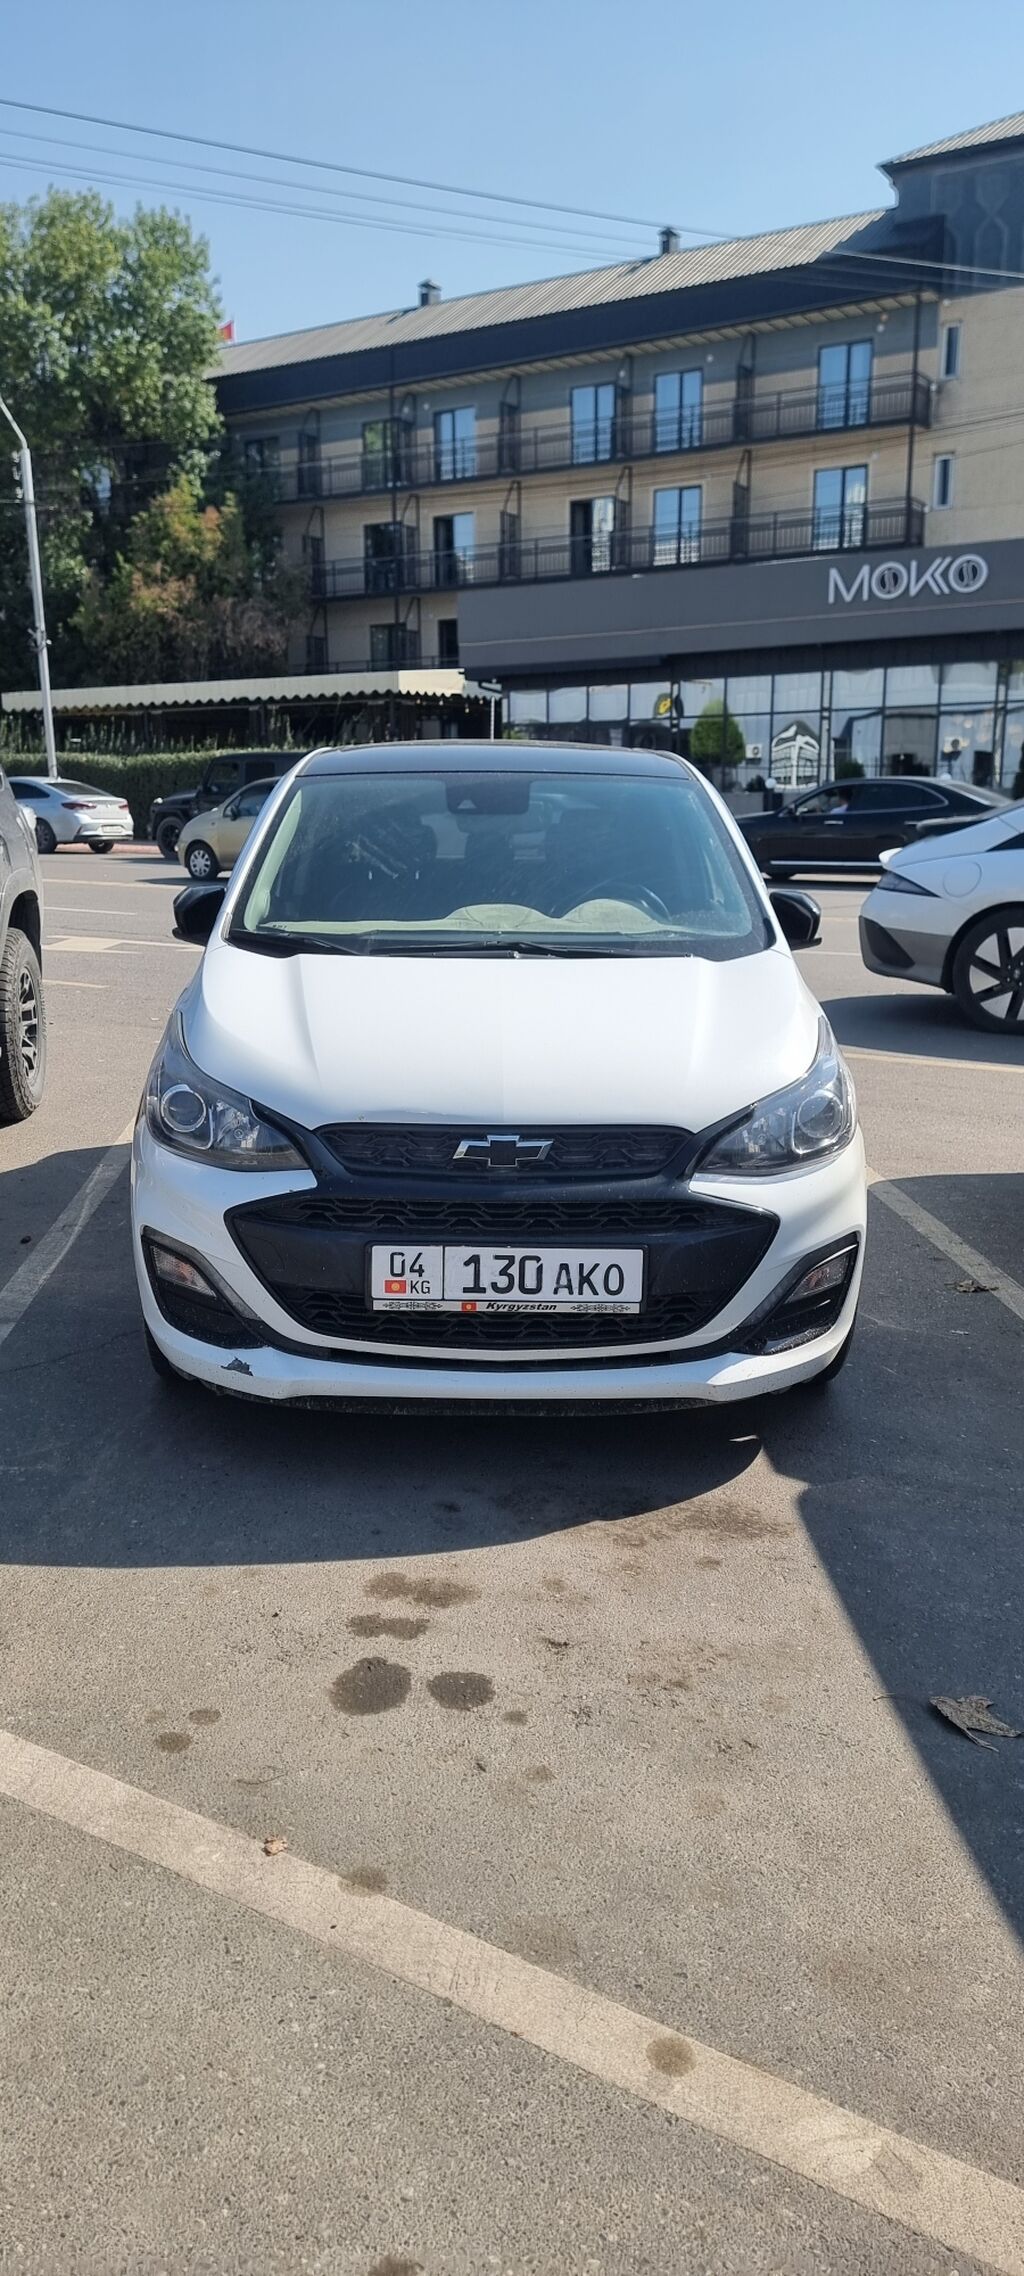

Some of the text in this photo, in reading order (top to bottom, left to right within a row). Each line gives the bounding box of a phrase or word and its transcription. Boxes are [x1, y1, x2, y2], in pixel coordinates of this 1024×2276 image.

[828, 553, 989, 604] MOKKO
[389, 1252, 425, 1278] 04
[462, 1254, 625, 1296] 130 AKO
[410, 1280, 431, 1294] KG
[486, 1302, 557, 1312] Kyrgyzstan
